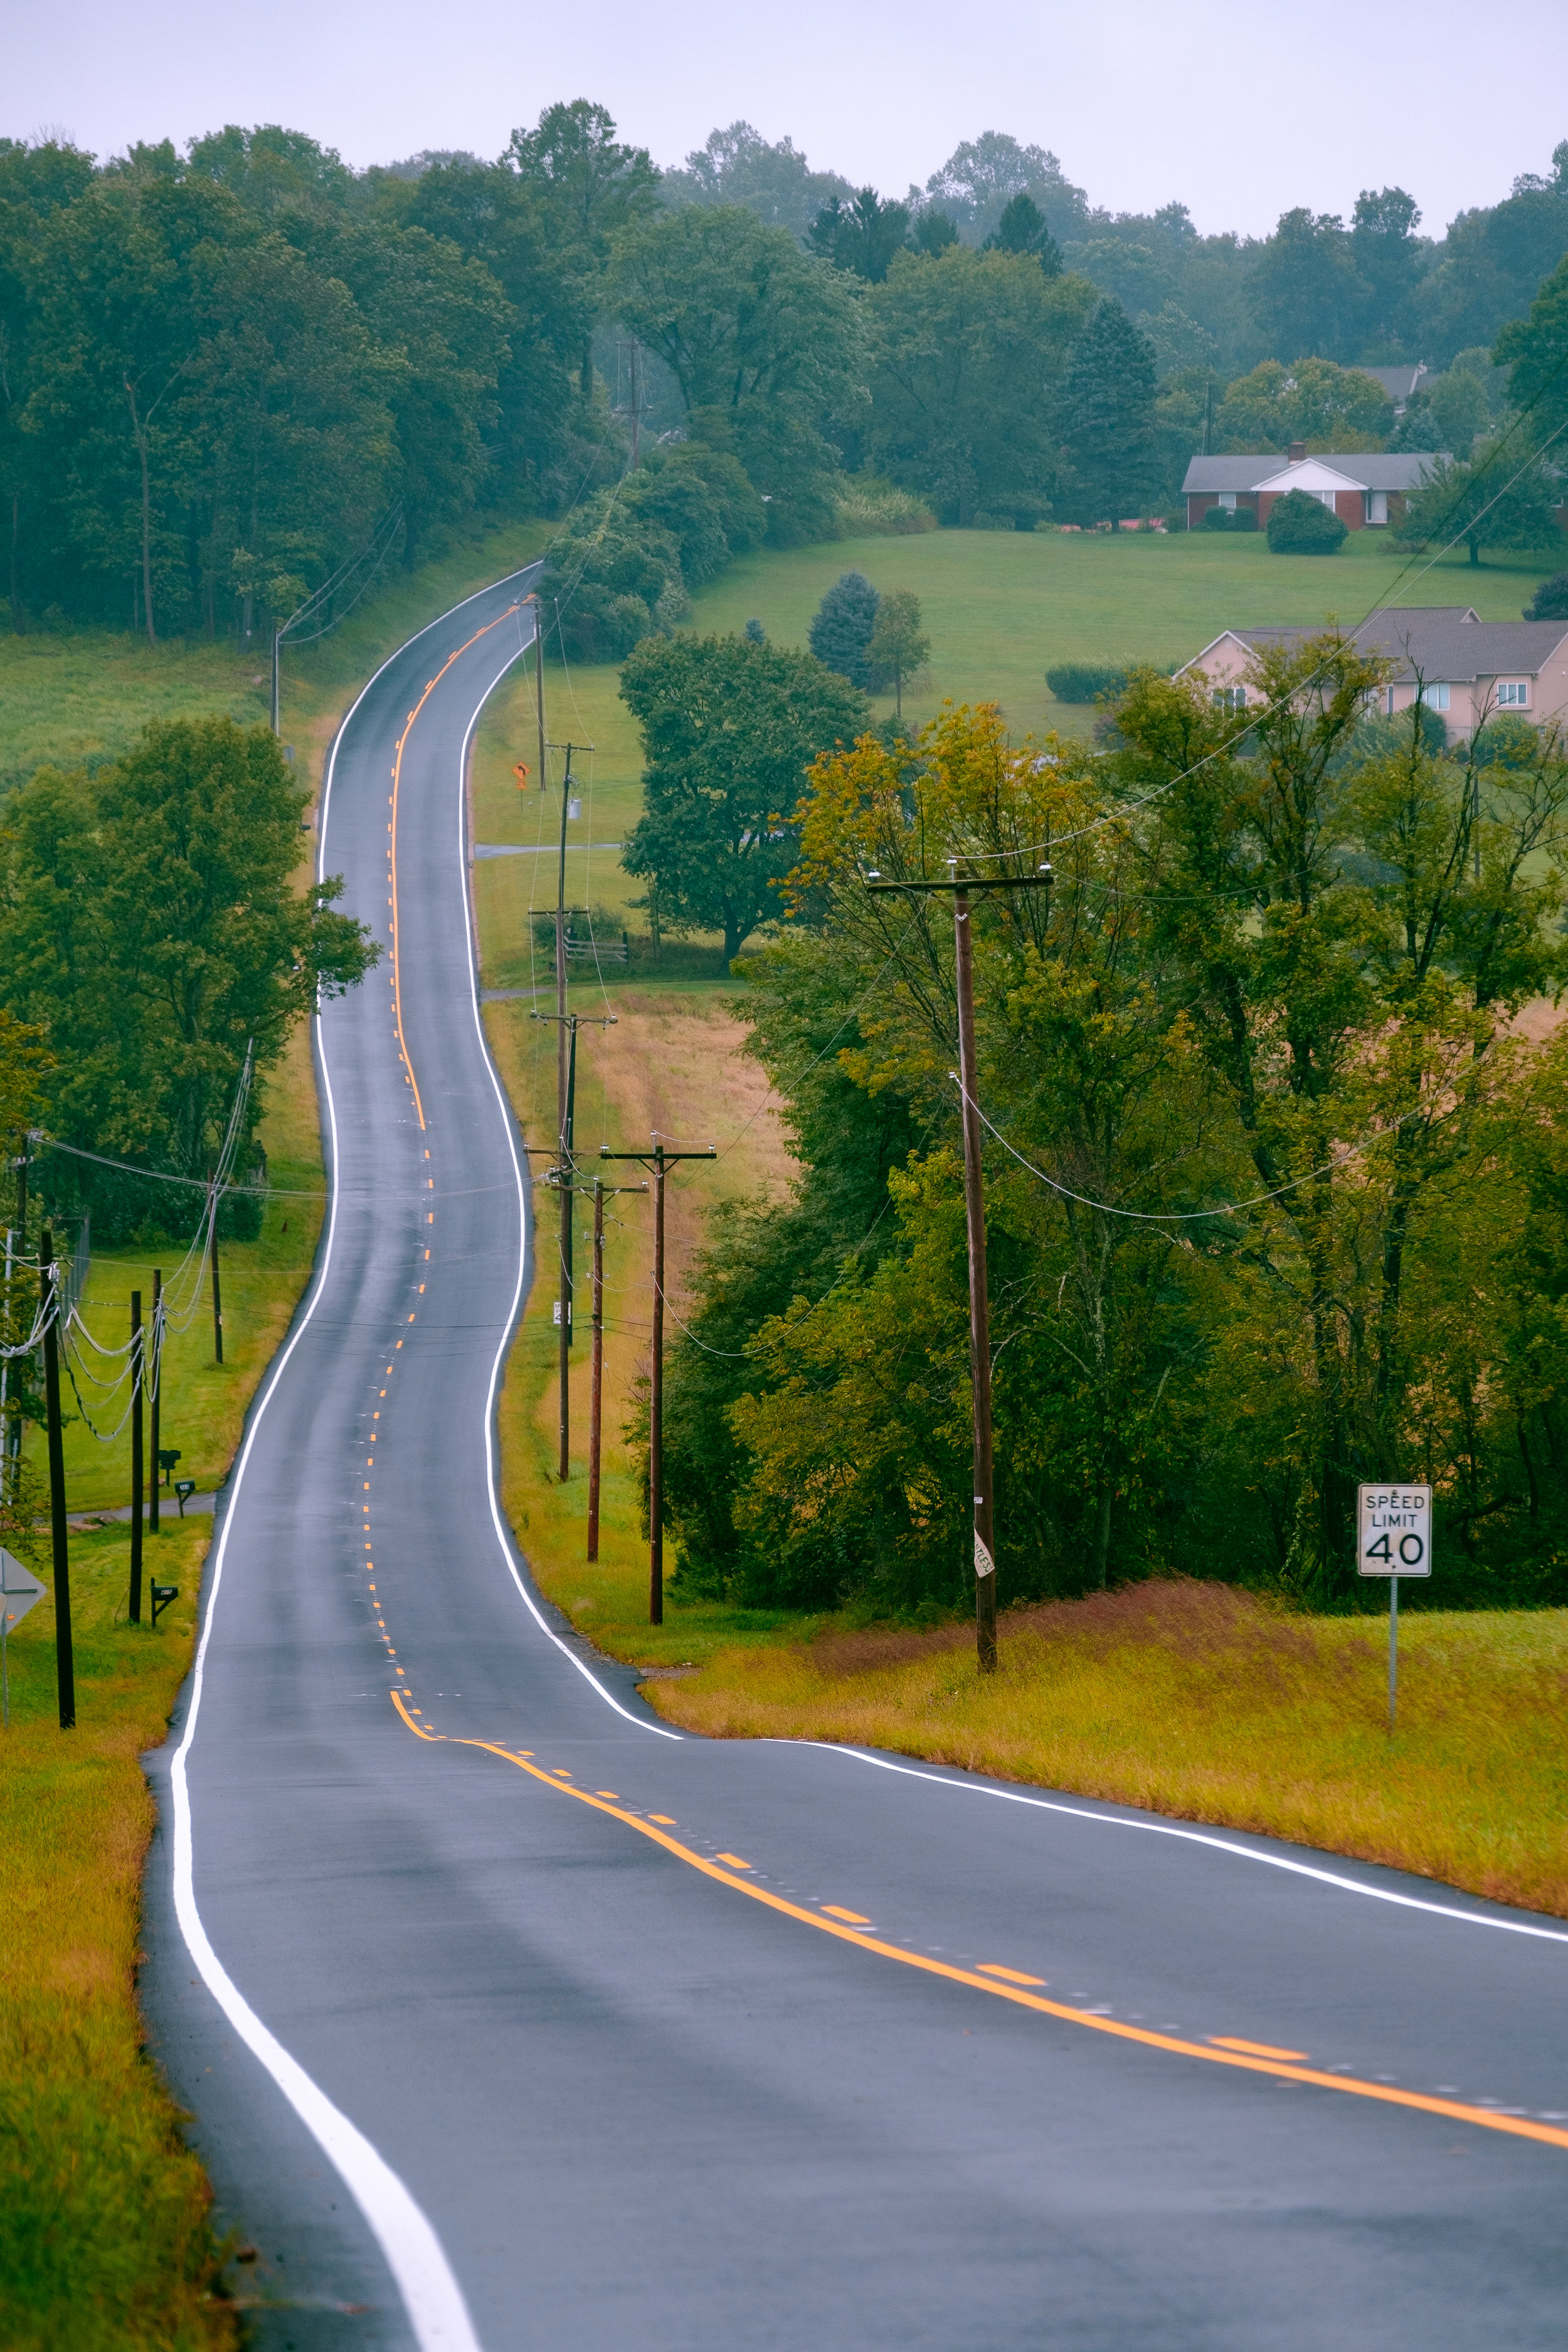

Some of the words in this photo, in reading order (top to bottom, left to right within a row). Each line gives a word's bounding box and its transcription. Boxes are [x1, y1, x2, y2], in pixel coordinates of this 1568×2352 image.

[1367, 1496, 1424, 1509] SPEED
[1372, 1515, 1417, 1527] LIMIT
[1366, 1534, 1424, 1565] 40
